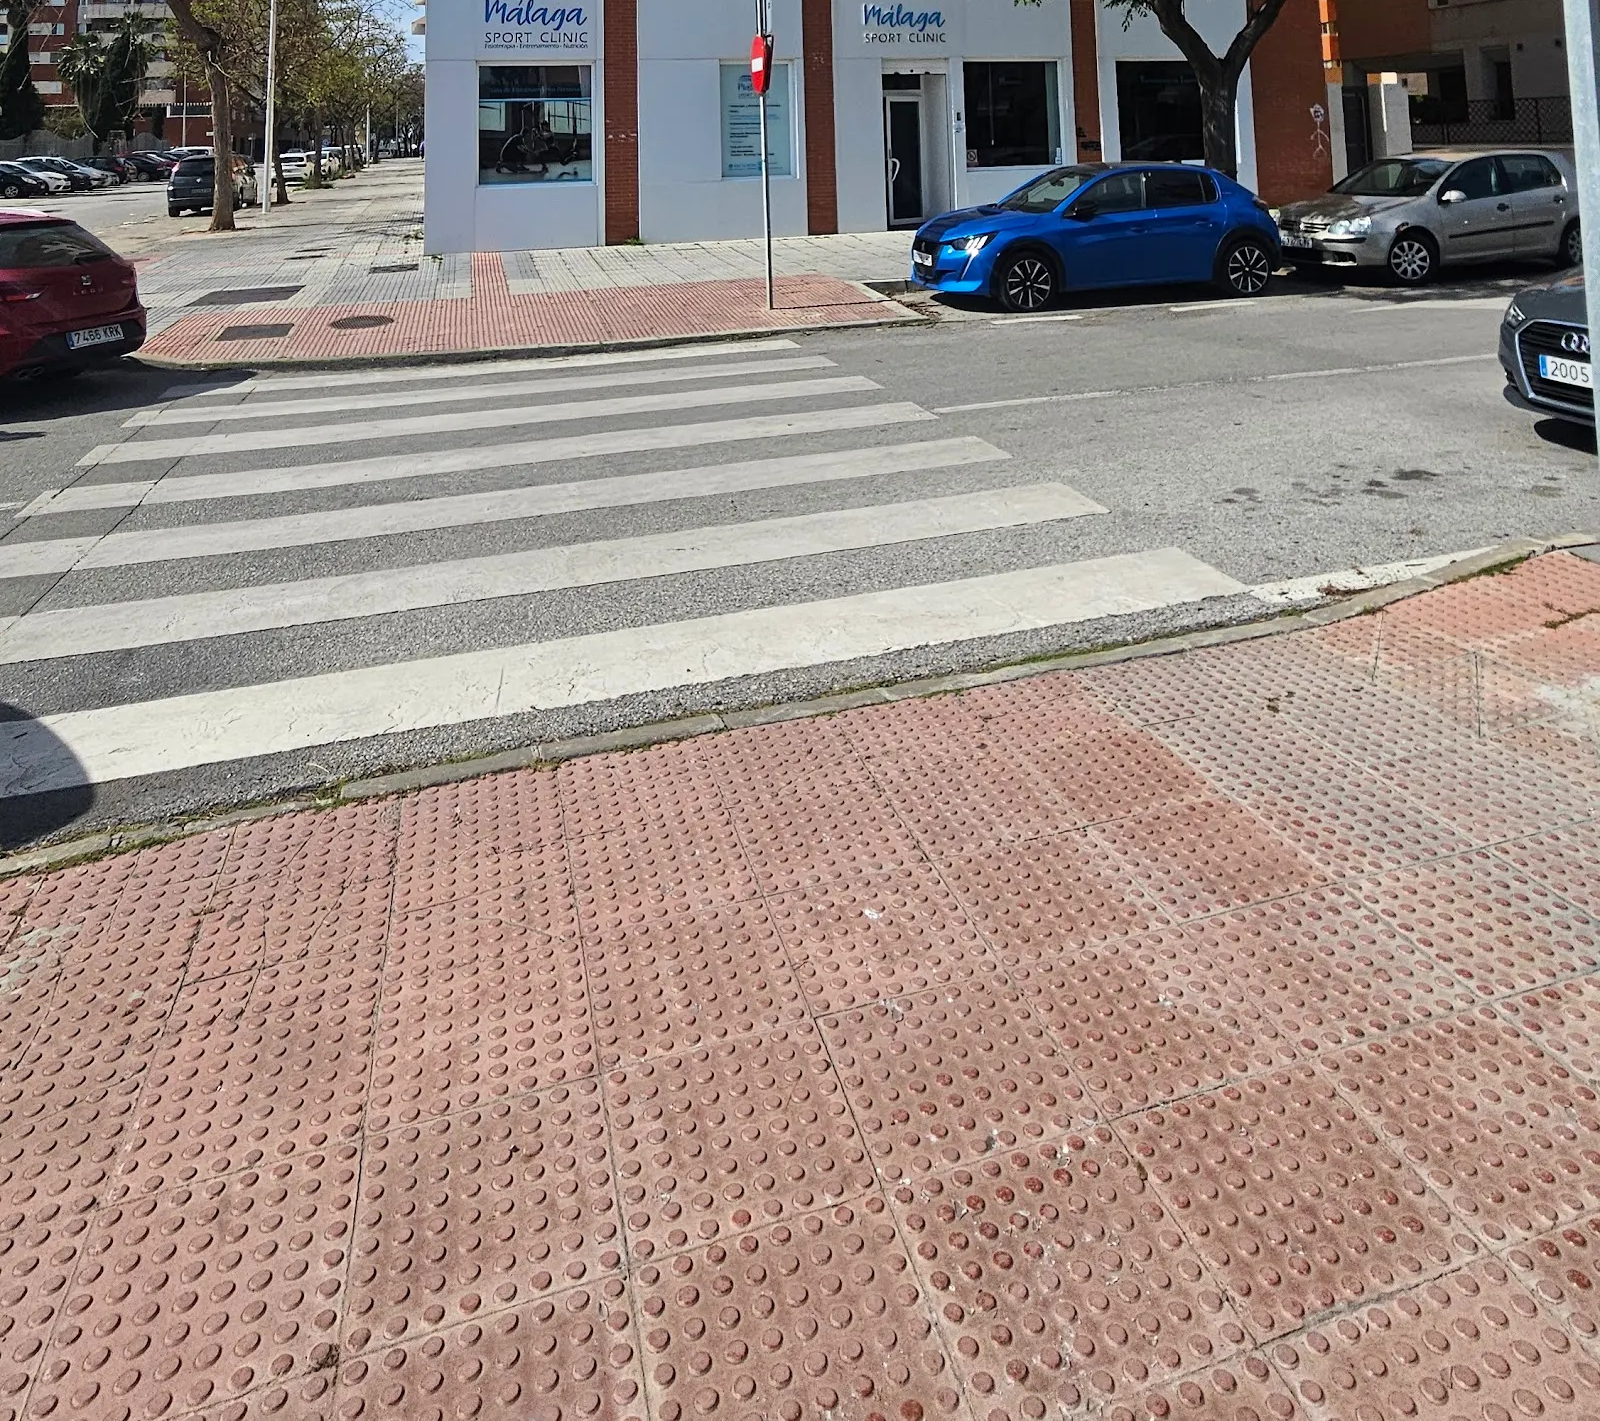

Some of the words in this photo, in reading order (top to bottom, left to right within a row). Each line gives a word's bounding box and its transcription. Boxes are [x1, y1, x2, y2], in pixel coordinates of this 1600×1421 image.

[863, 3, 946, 32] Málaga
[484, 32, 533, 43] SPORT
[540, 32, 588, 43] CLINIC
[864, 33, 902, 43] SPORT
[908, 32, 946, 43] CLINIC
[484, 43, 516, 51] Fisioterapia
[74, 329, 101, 344] 7466
[102, 326, 121, 338] KRK
[1550, 361, 1589, 383] 2005
